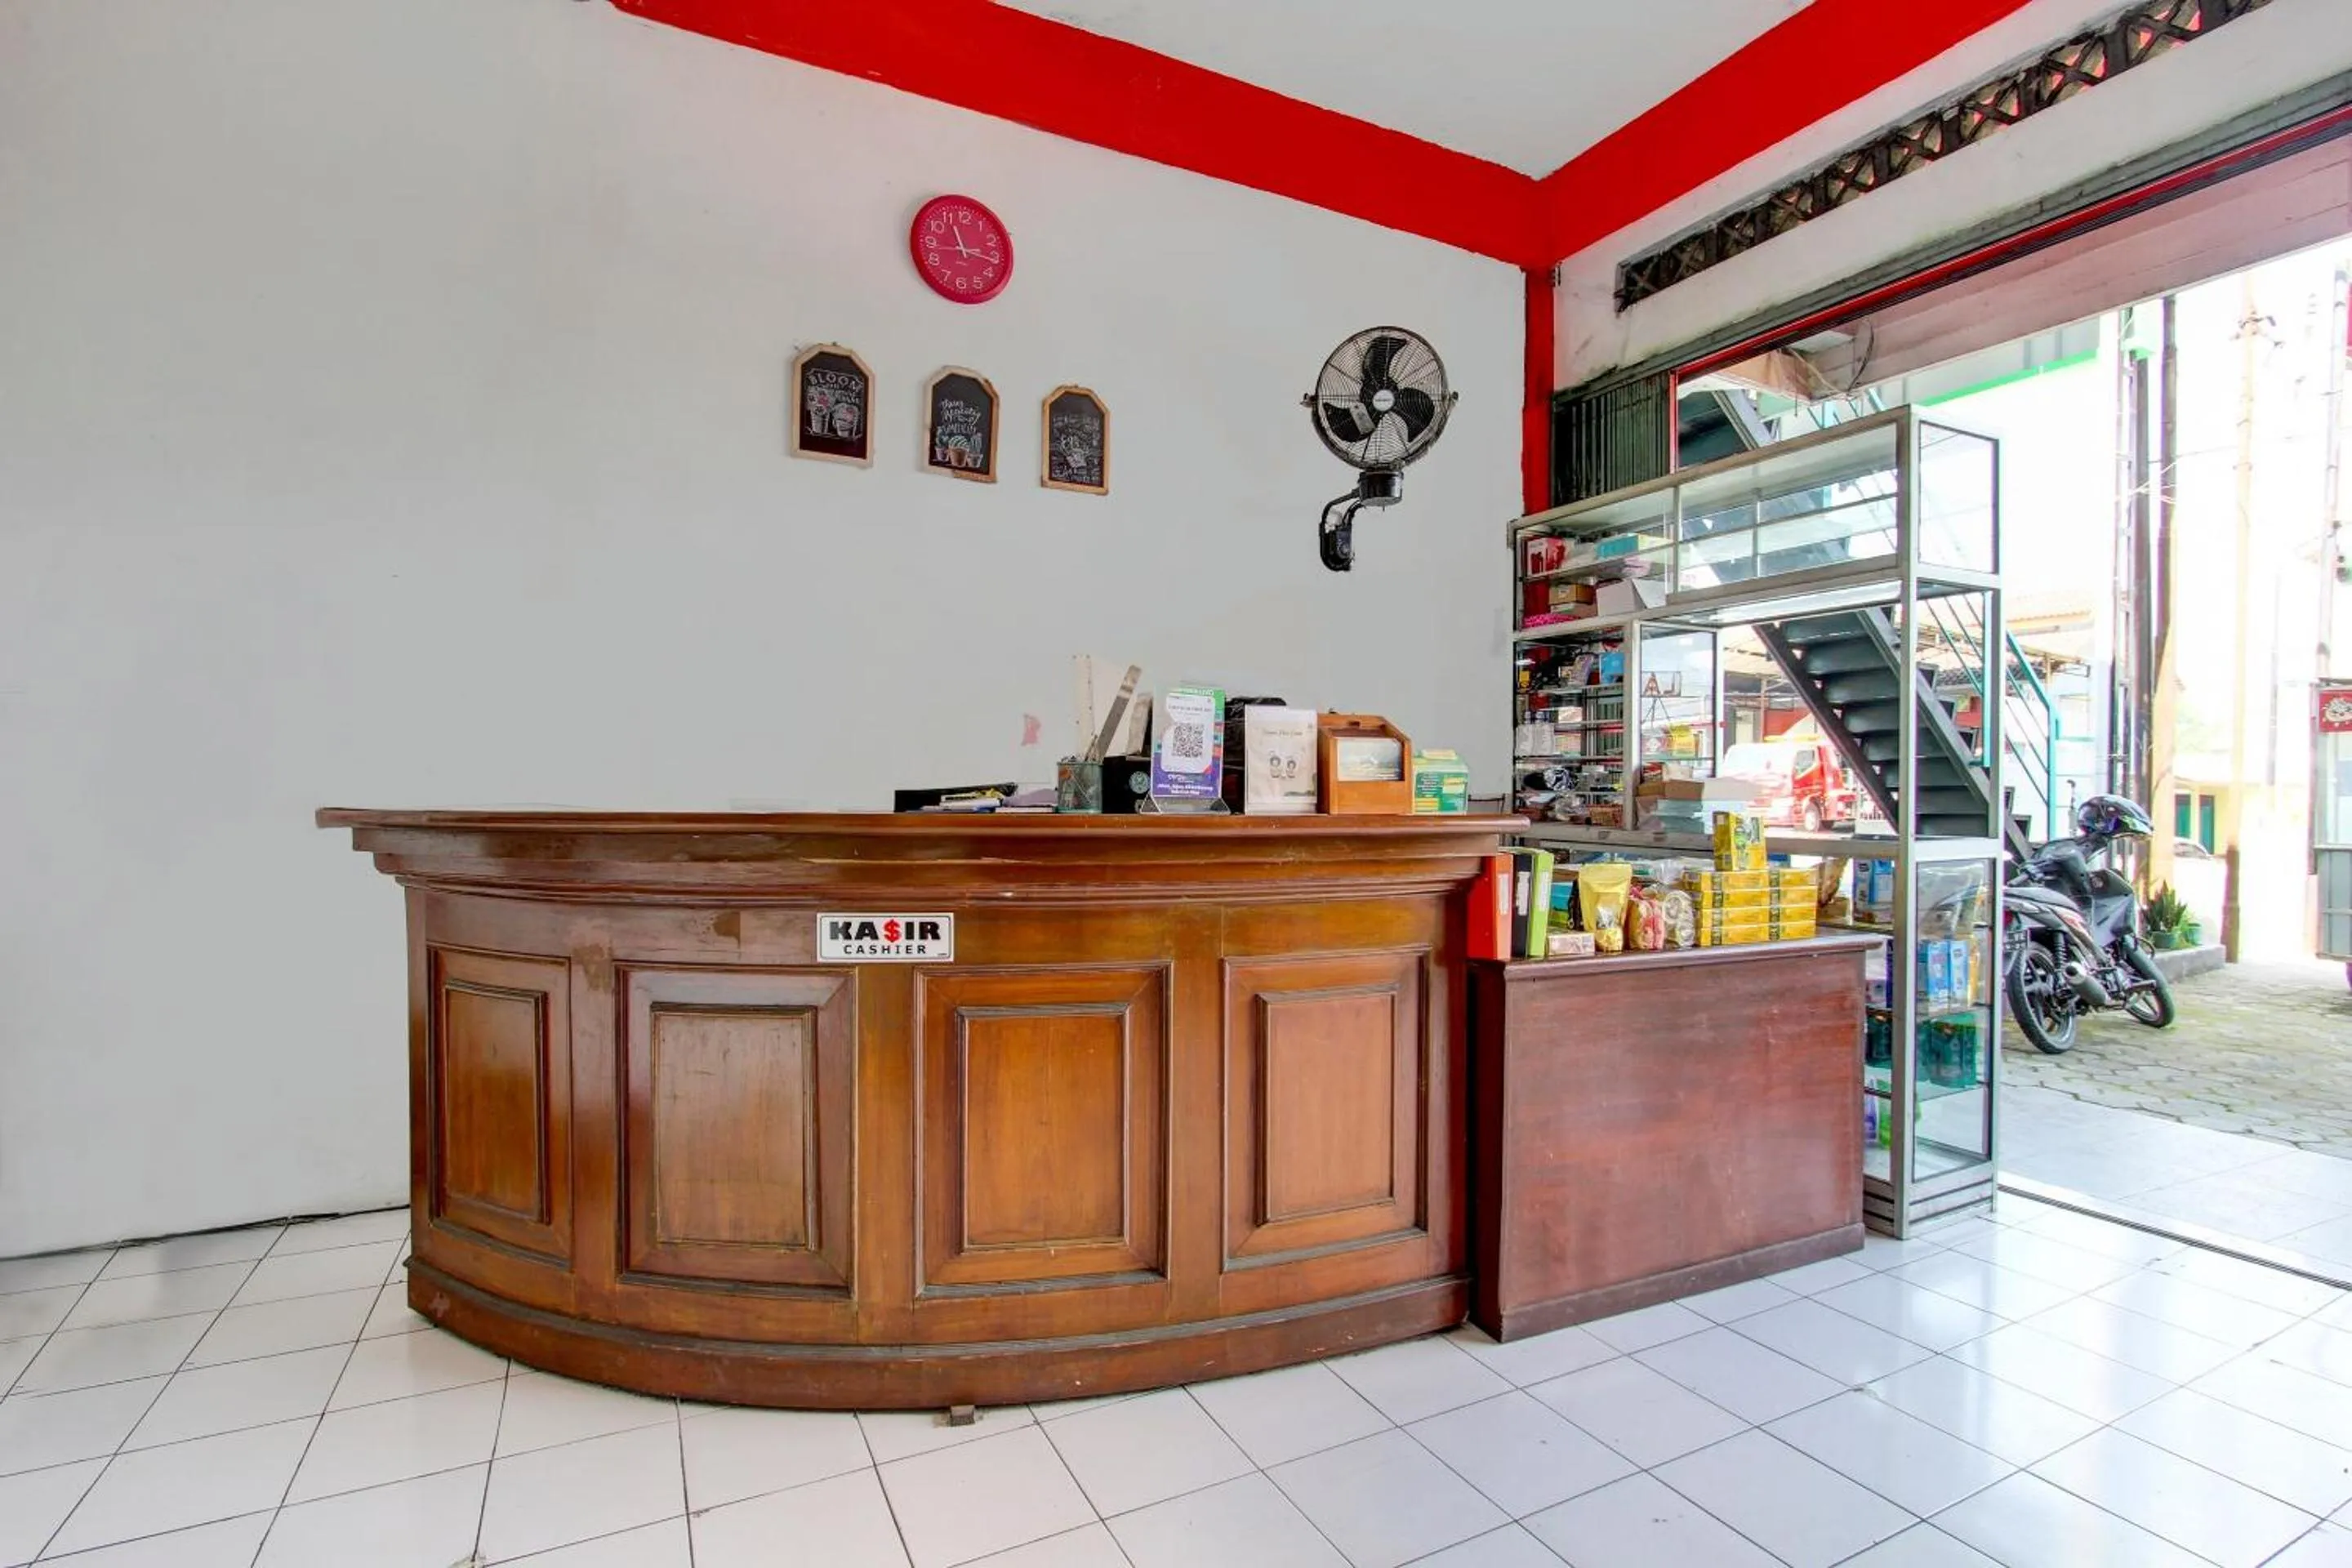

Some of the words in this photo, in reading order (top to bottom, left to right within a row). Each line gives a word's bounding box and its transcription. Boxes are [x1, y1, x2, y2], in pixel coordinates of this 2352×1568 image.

[942, 211, 953, 225] 11
[958, 211, 971, 225] 12
[930, 220, 945, 234] 10
[924, 235, 937, 248] 9
[987, 234, 996, 247] 2
[928, 252, 939, 266] 8
[988, 249, 1000, 264] 3
[941, 269, 951, 281] 7
[982, 265, 994, 278] 4
[956, 276, 967, 289] 6
[973, 275, 983, 289] 5
[843, 944, 926, 955] CASHIER
